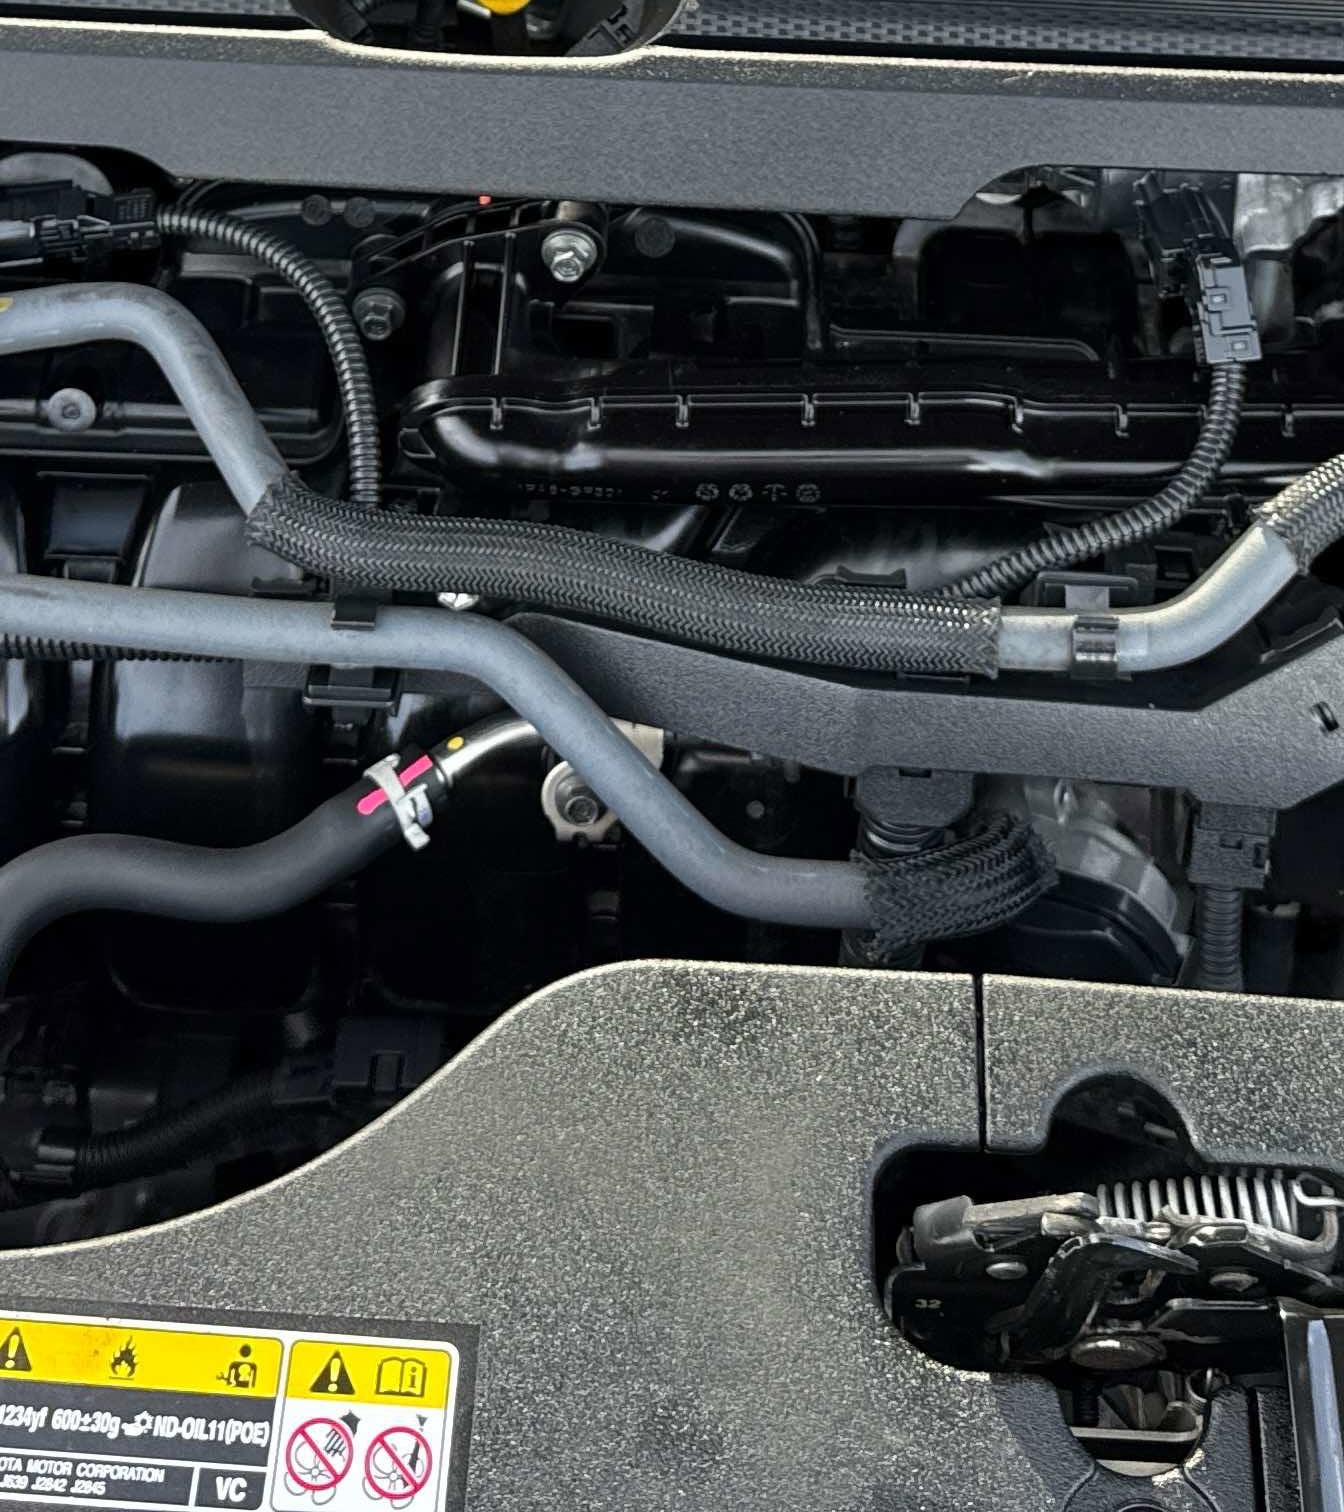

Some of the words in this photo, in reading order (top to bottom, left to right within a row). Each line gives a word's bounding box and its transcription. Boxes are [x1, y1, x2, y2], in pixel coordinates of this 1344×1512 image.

[52, 1408, 122, 1439] 600±30g
[155, 1416, 270, 1448] ND-OIL11(POE)
[26, 1458, 73, 1477] MOTOR
[76, 1461, 166, 1483] CORPORATION
[215, 1476, 248, 1502] VC
